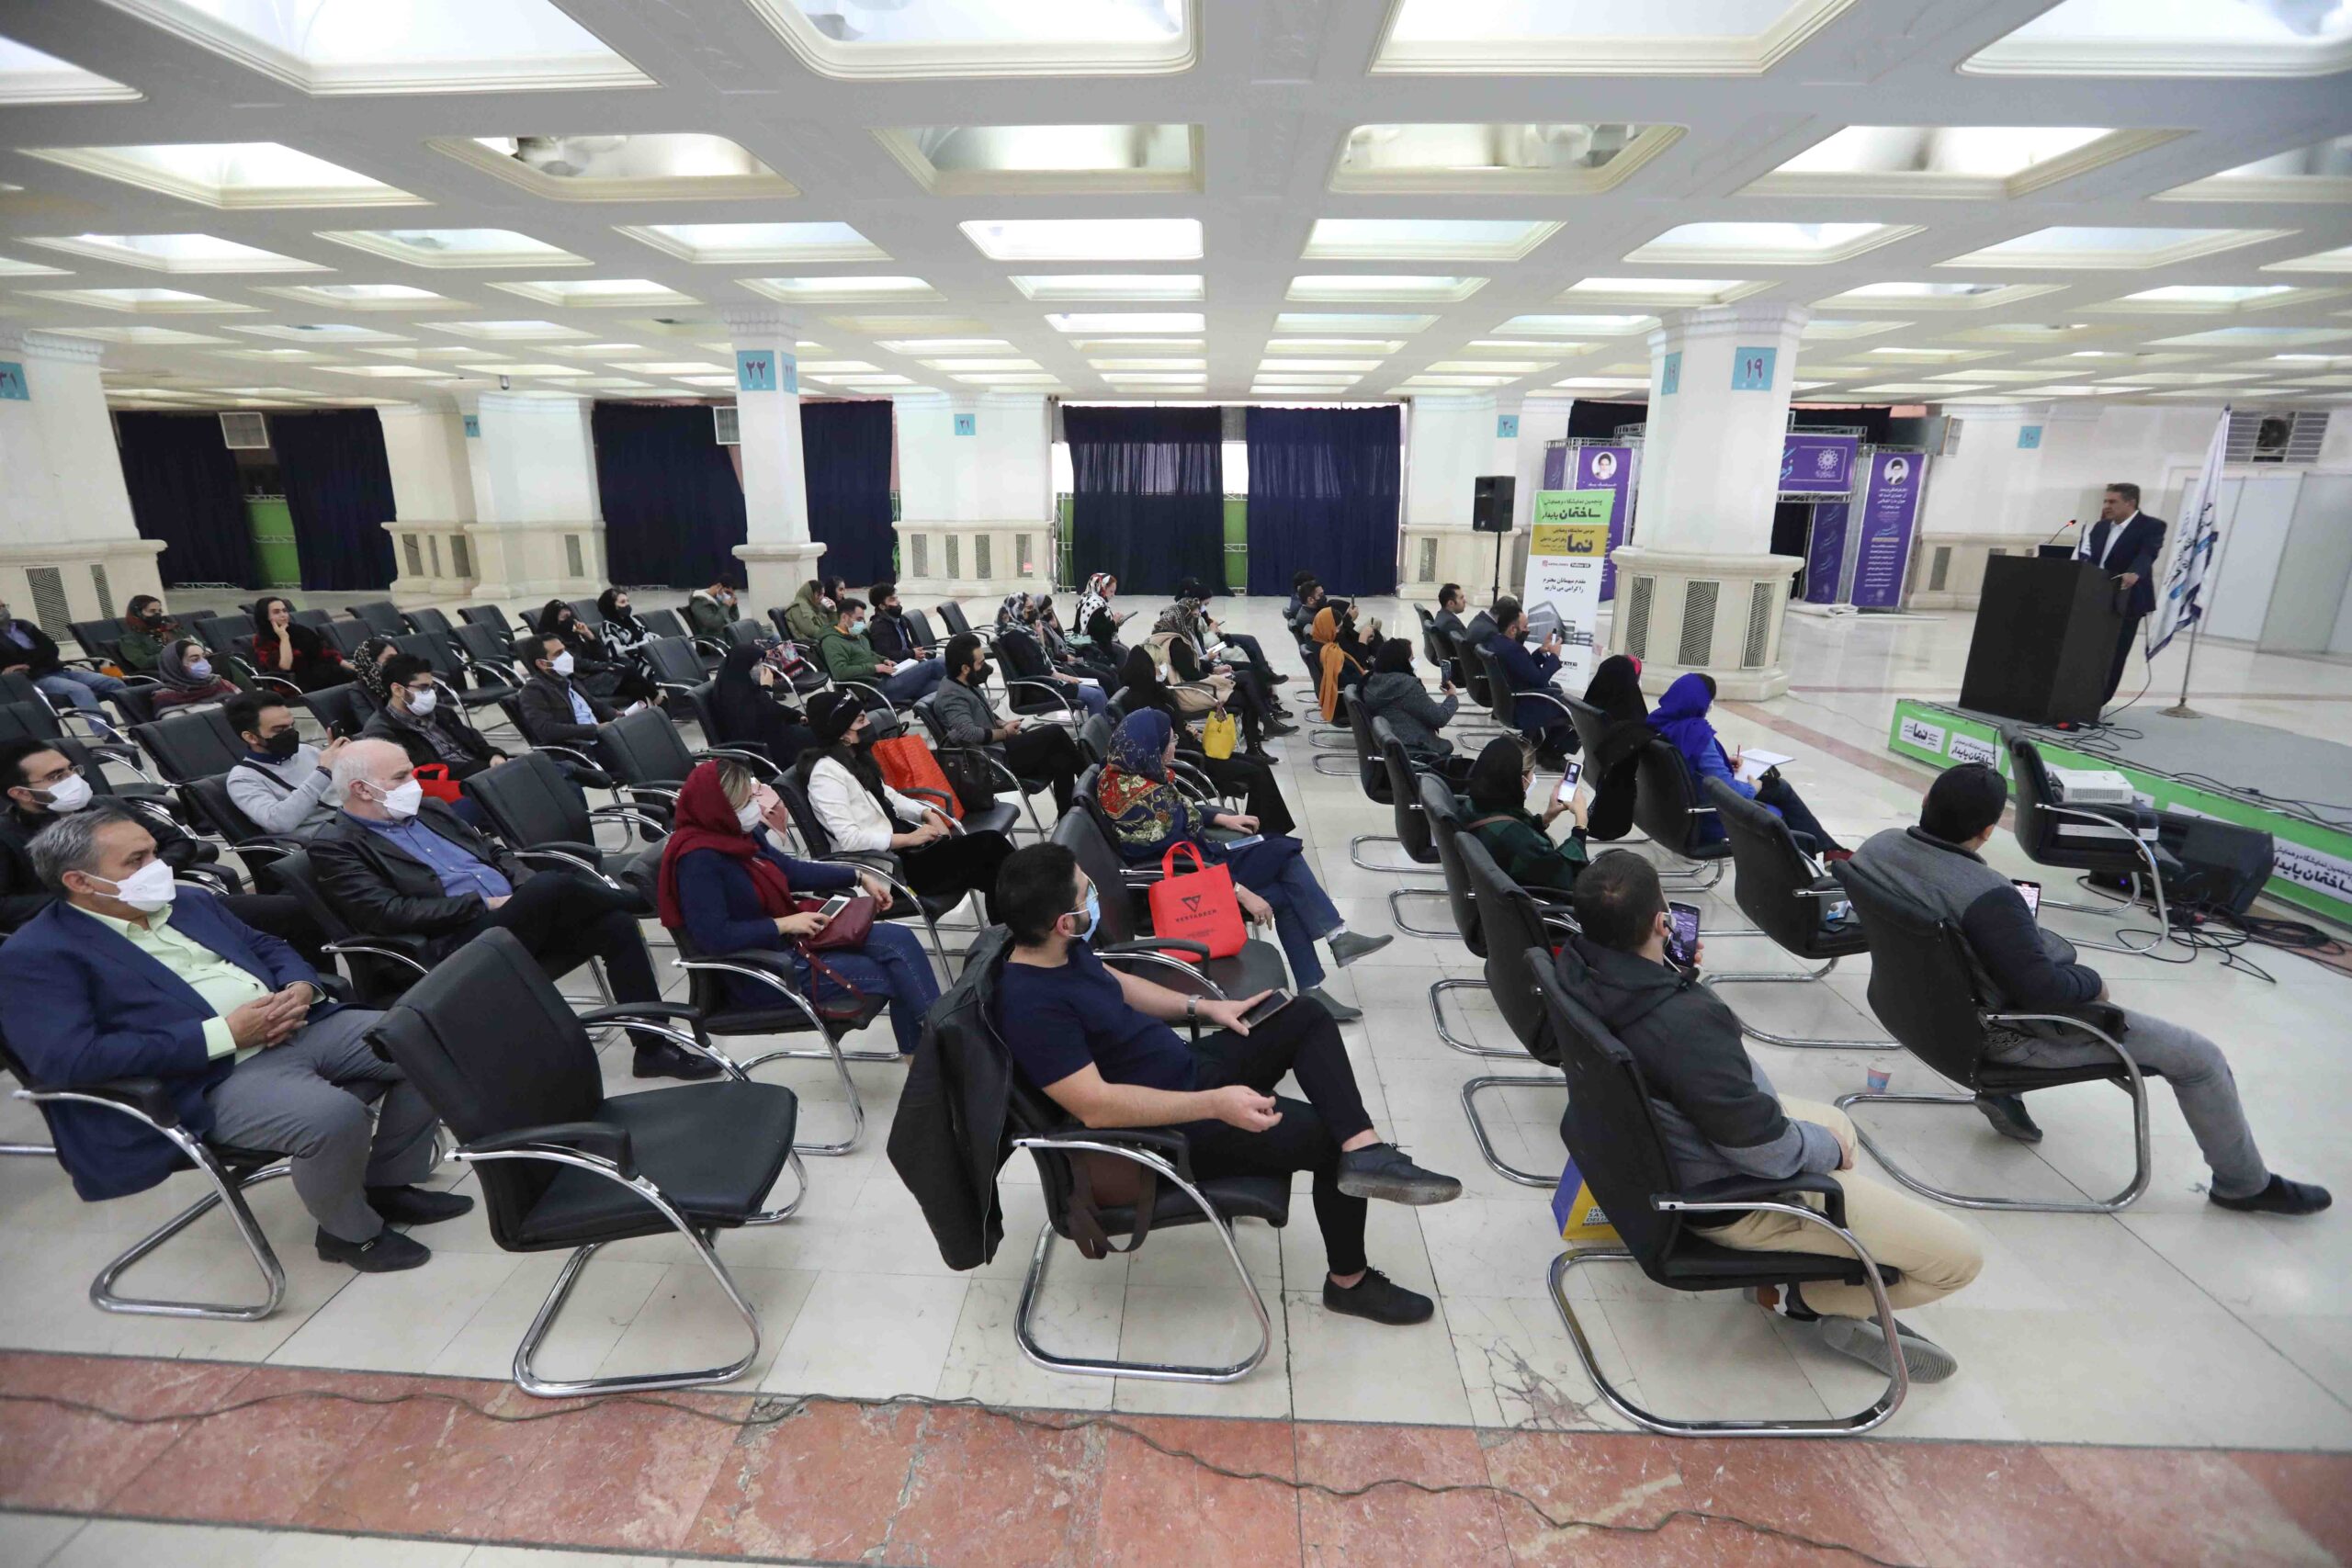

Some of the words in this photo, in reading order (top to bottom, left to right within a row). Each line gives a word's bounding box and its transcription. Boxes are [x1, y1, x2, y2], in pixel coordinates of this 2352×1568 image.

[1747, 357, 1763, 379] ۱۹
[1502, 420, 1514, 432] ۲۰
[1542, 511, 1559, 521] پایدار
[1558, 506, 1601, 520] ساختمان
[1566, 533, 1594, 553] نما
[1913, 722, 1928, 740] نما
[1951, 746, 1969, 761] پایدار
